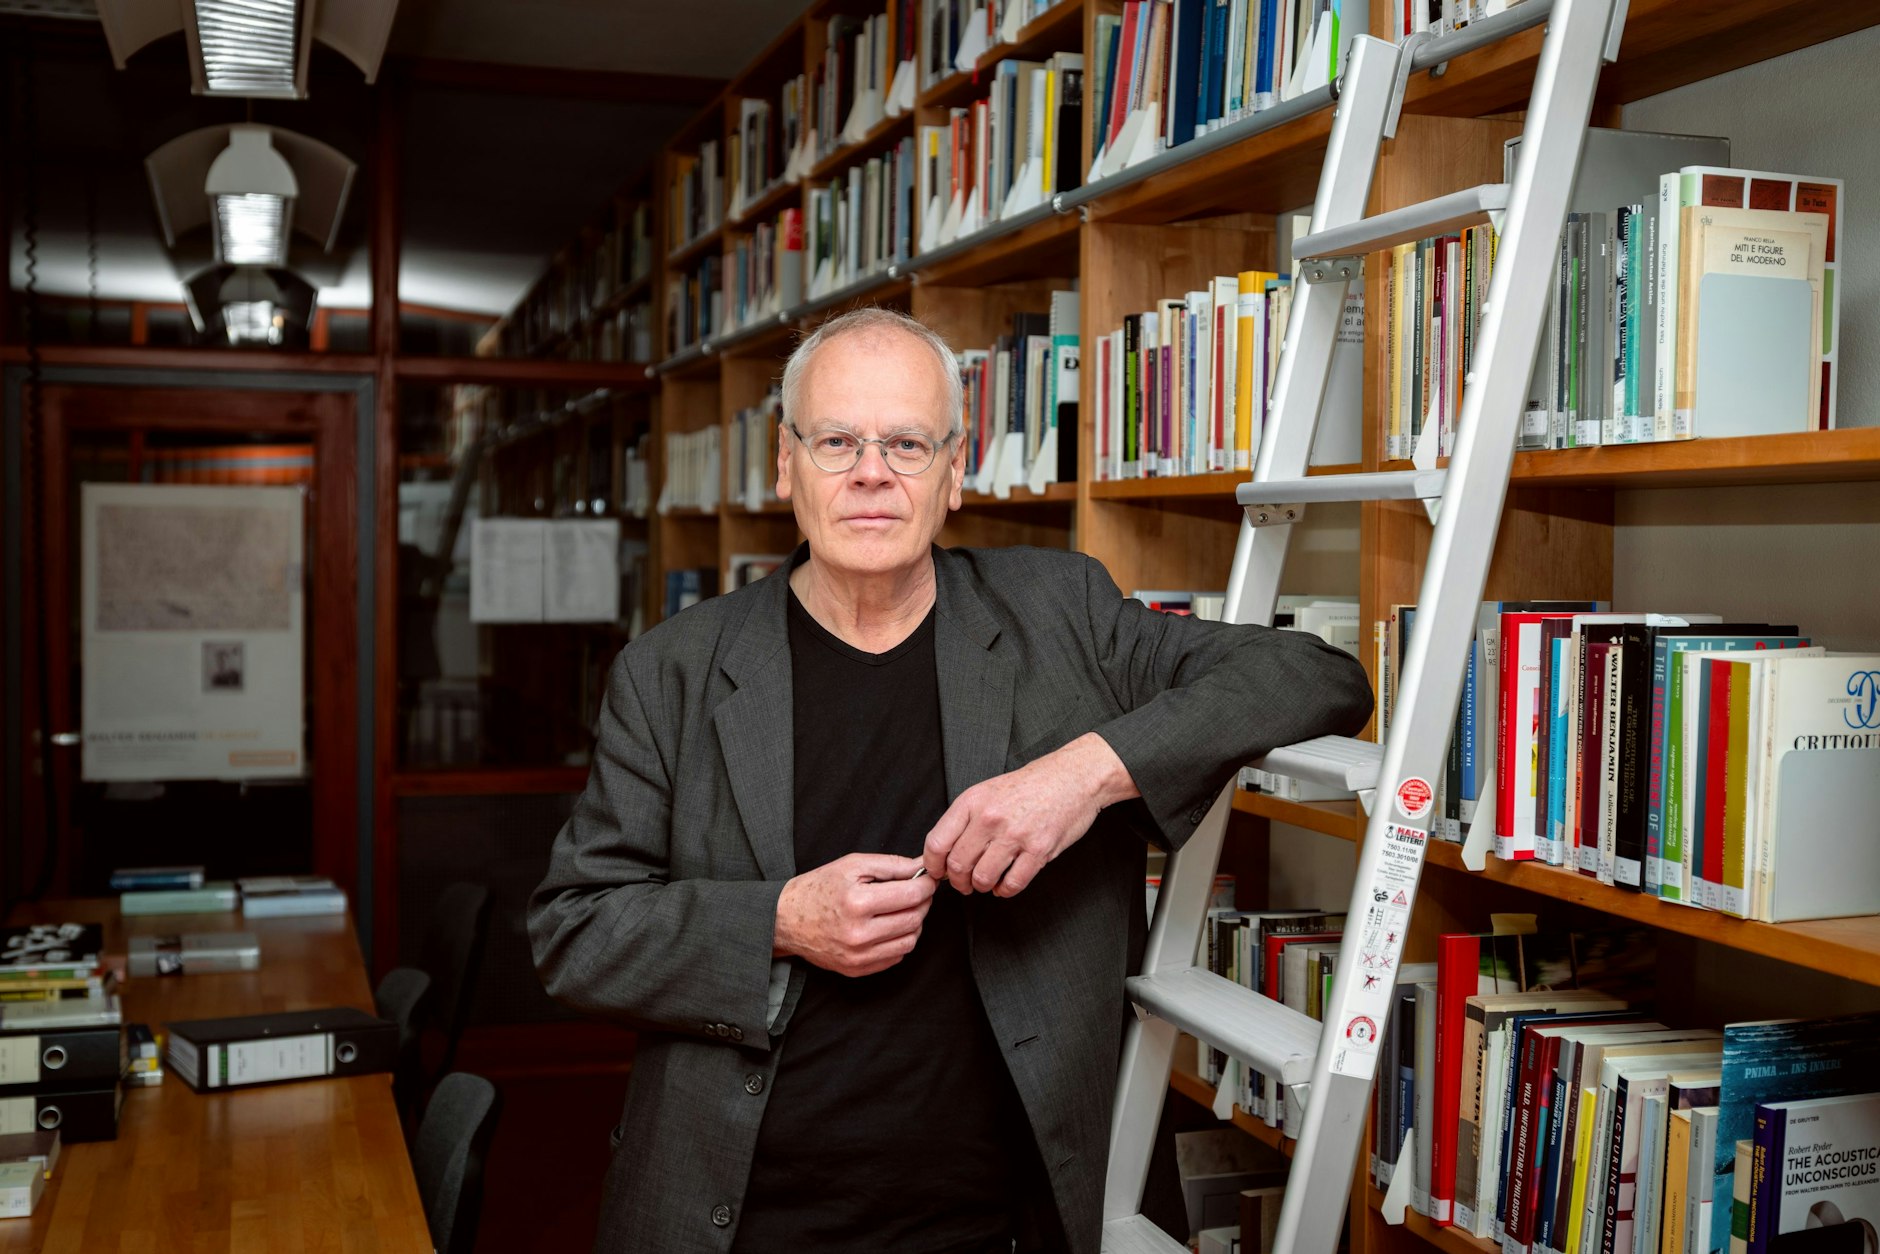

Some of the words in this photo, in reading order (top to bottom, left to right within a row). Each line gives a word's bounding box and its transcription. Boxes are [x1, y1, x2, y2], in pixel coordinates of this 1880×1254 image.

[1731, 254, 1743, 263] DEL
[1746, 256, 1786, 266] MODERNO
[1734, 244, 1750, 253] MITI
[1758, 246, 1784, 255] FIGURE
[1655, 656, 1664, 681] THE
[1608, 710, 1616, 781] BENJAMIN
[1650, 687, 1664, 808] DISENCHANTMENT
[1794, 734, 1880, 750] CRITIQU
[1649, 814, 1658, 831] OF
[1276, 923, 1304, 932] Walter
[1744, 1065, 1776, 1079] PNIMA
[1791, 1063, 1807, 1074] INS
[1809, 1060, 1842, 1072] INNERE
[1523, 1082, 1532, 1106] WILD,
[1516, 1109, 1530, 1179] UNFORGETTABLE
[1610, 1105, 1624, 1196] PICTURING
[1788, 1145, 1811, 1155] Robert
[1813, 1142, 1832, 1153] Ryder
[1788, 1157, 1811, 1170] THE
[1814, 1147, 1880, 1167] ACOUSTICA
[1786, 1162, 1876, 1186] UNCONSCIOUS
[1852, 1178, 1879, 1186] ALEXANDER
[1510, 1180, 1522, 1233] PHILOSOPHY
